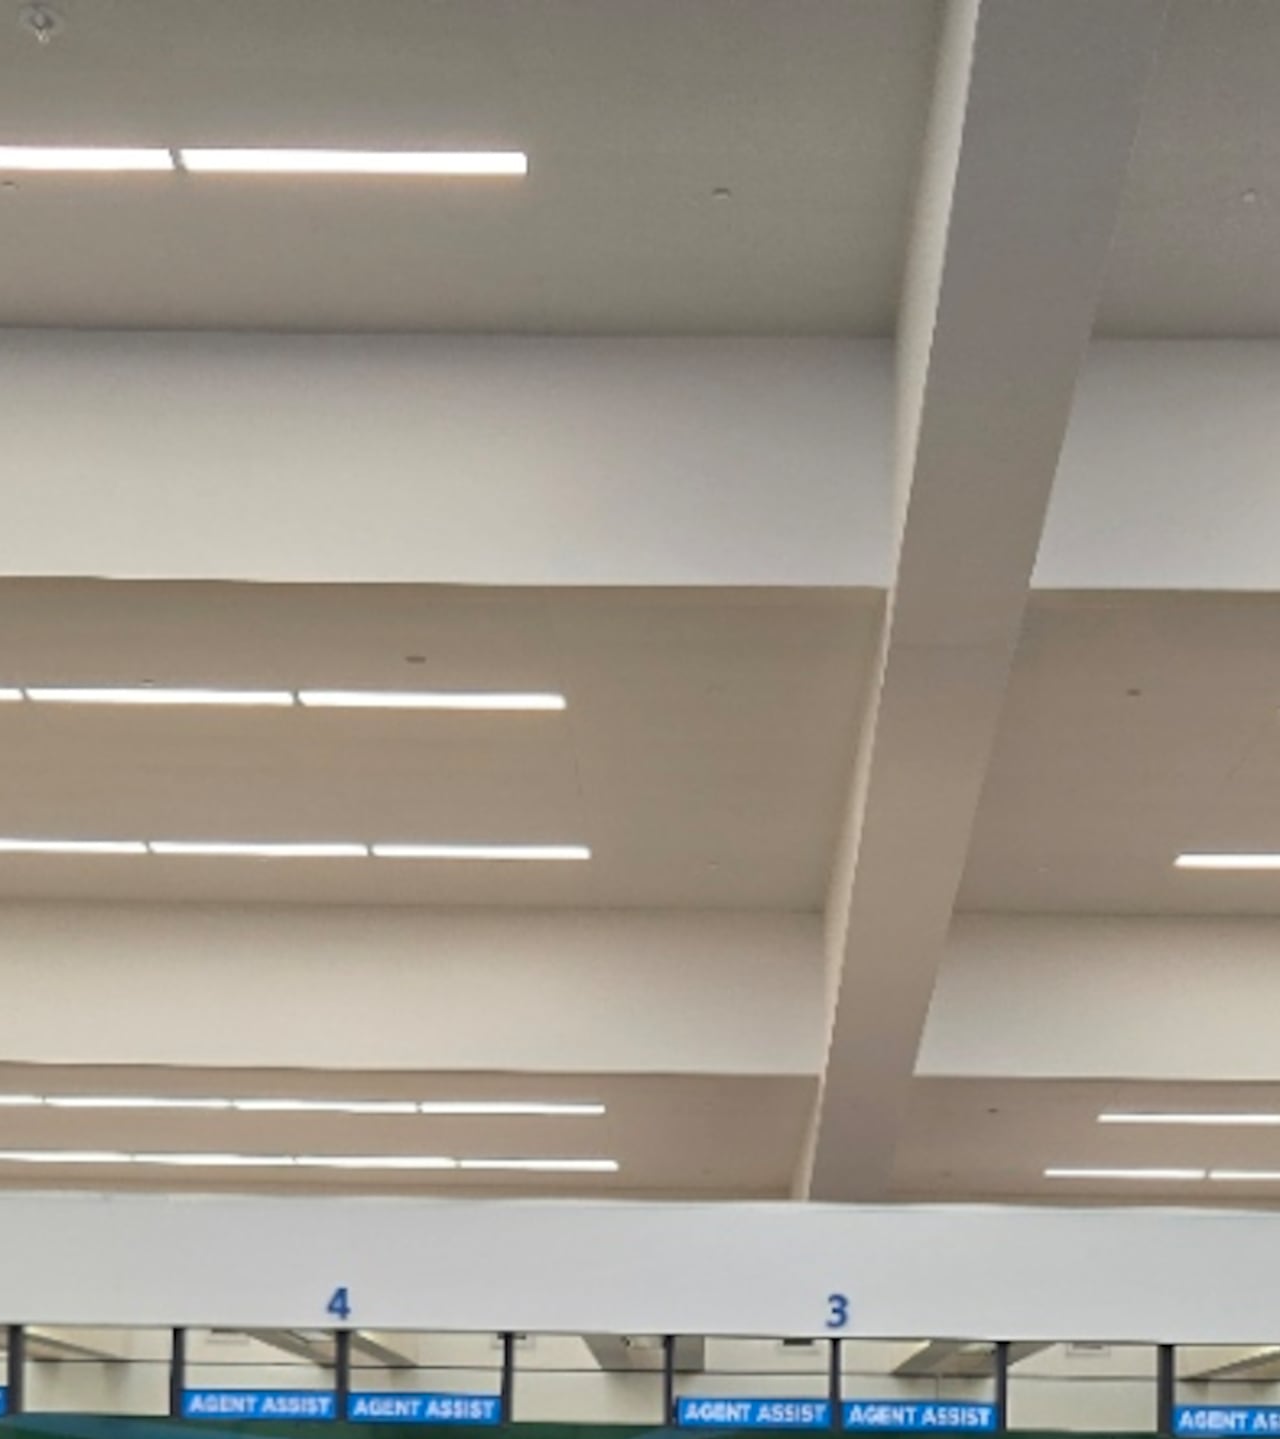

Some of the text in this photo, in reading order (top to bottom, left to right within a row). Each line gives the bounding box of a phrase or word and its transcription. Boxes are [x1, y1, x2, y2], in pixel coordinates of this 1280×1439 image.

[327, 1288, 350, 1321] 4
[826, 1293, 849, 1328] 3
[189, 1396, 332, 1414] AGENT ASSIST
[354, 1399, 494, 1419] AGENT ASSIST
[685, 1403, 826, 1423] AGENT ASSIST
[849, 1407, 991, 1427] AGENT ASSIST
[1178, 1410, 1246, 1429] AGENT
